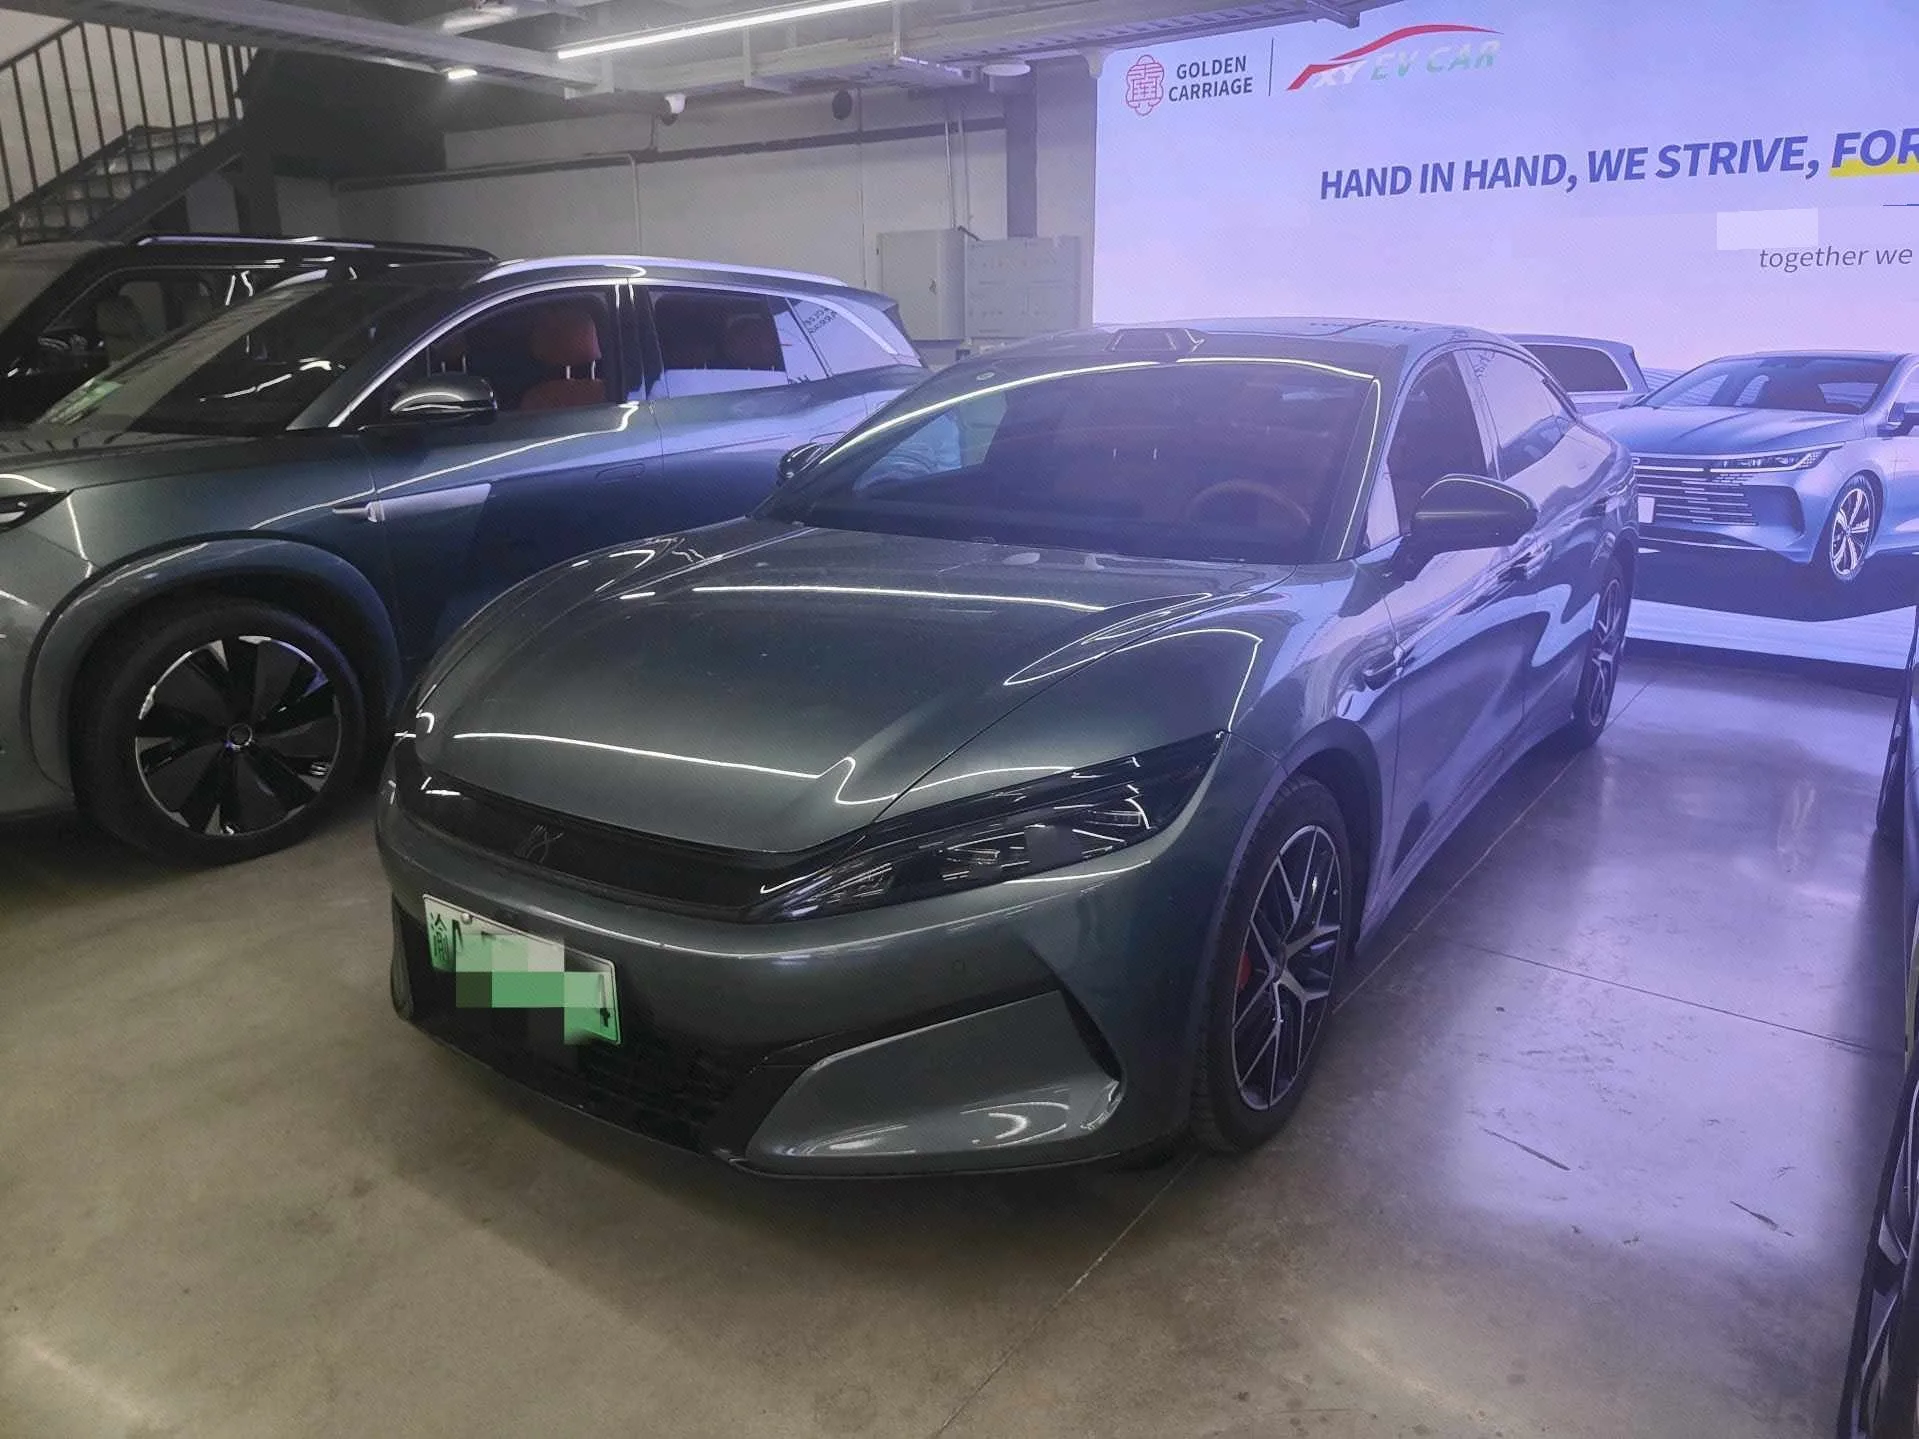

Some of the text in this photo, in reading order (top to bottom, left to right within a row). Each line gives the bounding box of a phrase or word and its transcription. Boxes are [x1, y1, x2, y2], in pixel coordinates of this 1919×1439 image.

[1176, 55, 1247, 80] GOLDEN
[1371, 50, 1420, 81] EV
[1427, 39, 1501, 73] CAR
[1168, 77, 1254, 102] CARRIAGE
[1320, 127, 1919, 200] HAND IN HAND, WE STRIVE, FOR
[1759, 245, 1914, 274] together we
